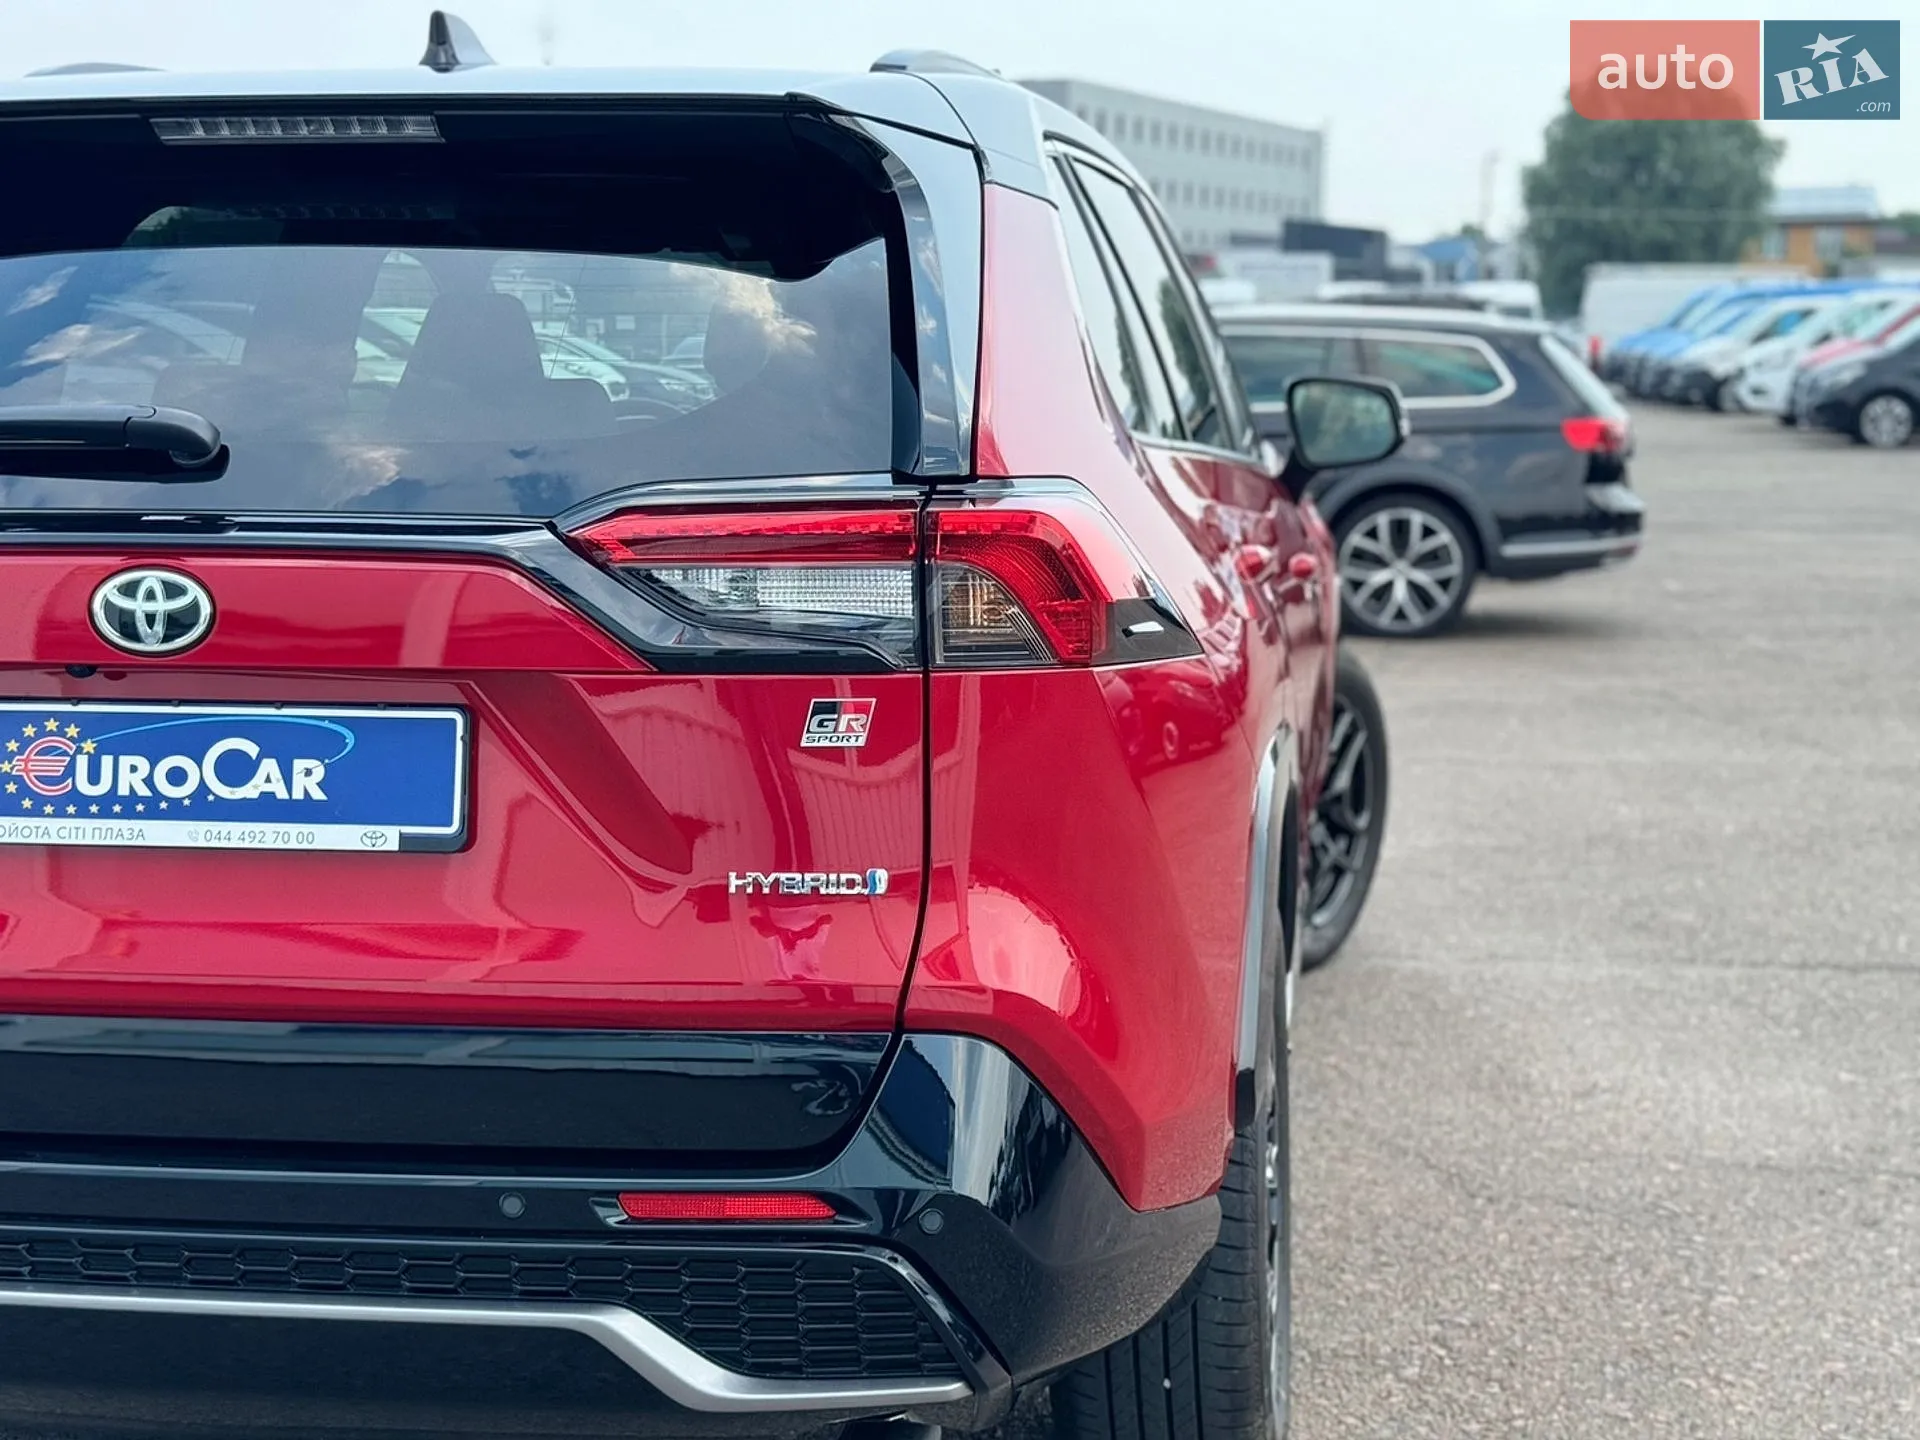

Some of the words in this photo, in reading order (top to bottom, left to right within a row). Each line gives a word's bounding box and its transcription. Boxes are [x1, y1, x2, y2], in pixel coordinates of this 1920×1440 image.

[808, 714, 868, 733] GR
[805, 734, 863, 745] SPORT
[56, 826, 86, 840] СІТІ
[92, 827, 146, 841] ПЛАЗА
[204, 829, 232, 843] 044
[237, 830, 267, 845] 492
[272, 830, 291, 845] 70
[296, 831, 316, 846] 00
[728, 871, 863, 895] HYBRID
